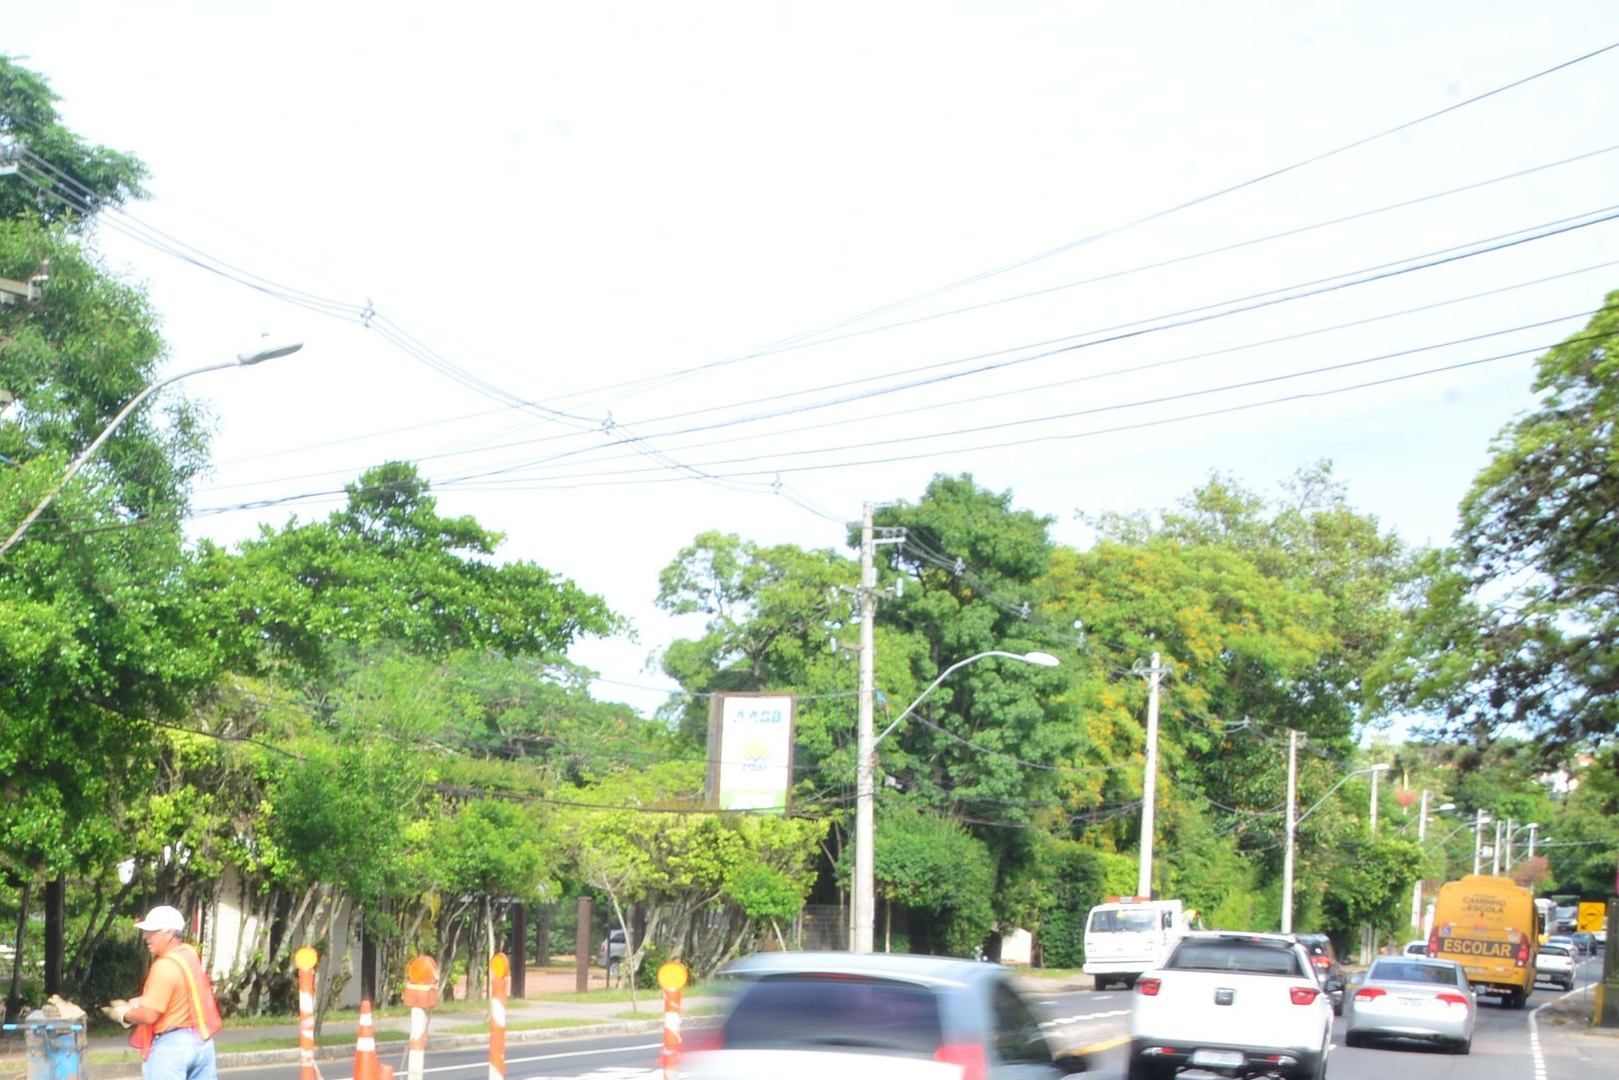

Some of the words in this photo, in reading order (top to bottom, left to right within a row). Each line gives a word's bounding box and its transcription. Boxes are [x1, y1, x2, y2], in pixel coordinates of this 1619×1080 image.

[1462, 896, 1506, 907] CAMINHO
[1467, 904, 1504, 914] ESCOLA
[1443, 939, 1512, 957] ESCOLAR
